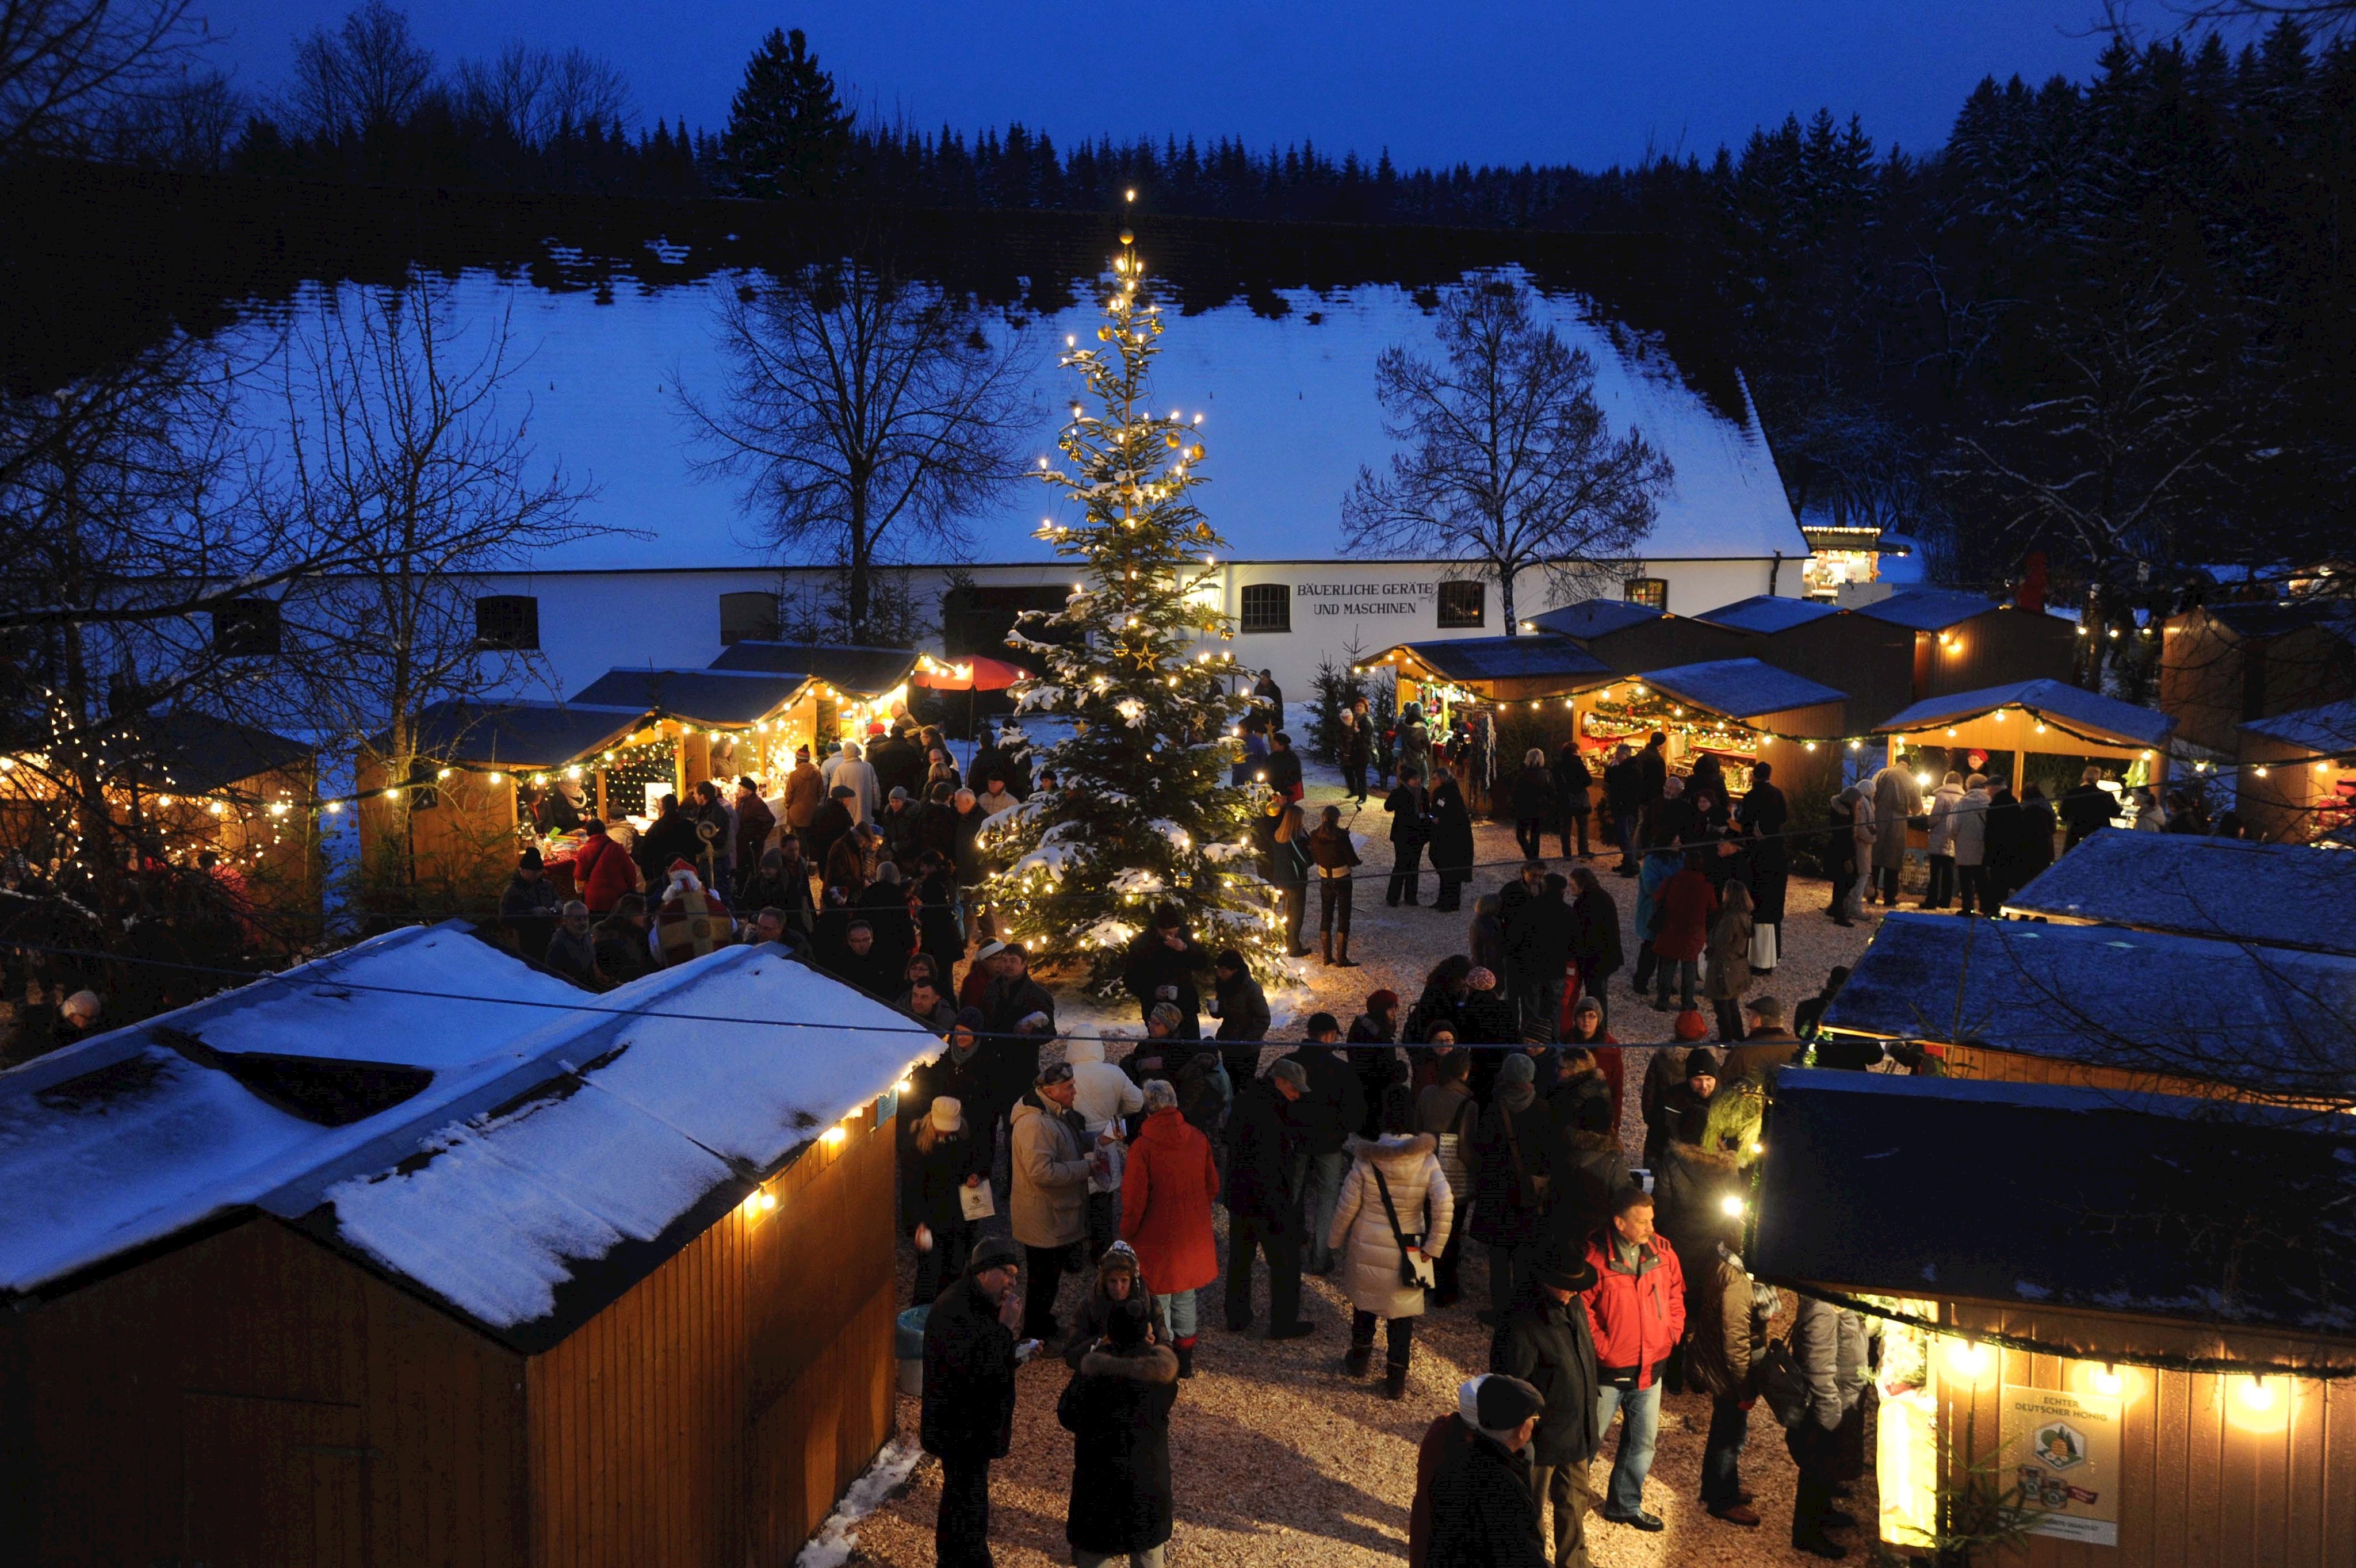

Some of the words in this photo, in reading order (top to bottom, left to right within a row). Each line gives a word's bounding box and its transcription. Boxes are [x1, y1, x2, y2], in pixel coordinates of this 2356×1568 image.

[1297, 583, 1379, 596] BÄUERLICHE
[1382, 582, 1433, 595] GERÄTE
[1314, 604, 1340, 615] UND
[1344, 603, 1416, 614] MASCHINEN
[2043, 1397, 2079, 1408] ECHTER
[2015, 1402, 2070, 1416] DEUTSCHER
[2073, 1411, 2108, 1421] HONIG
